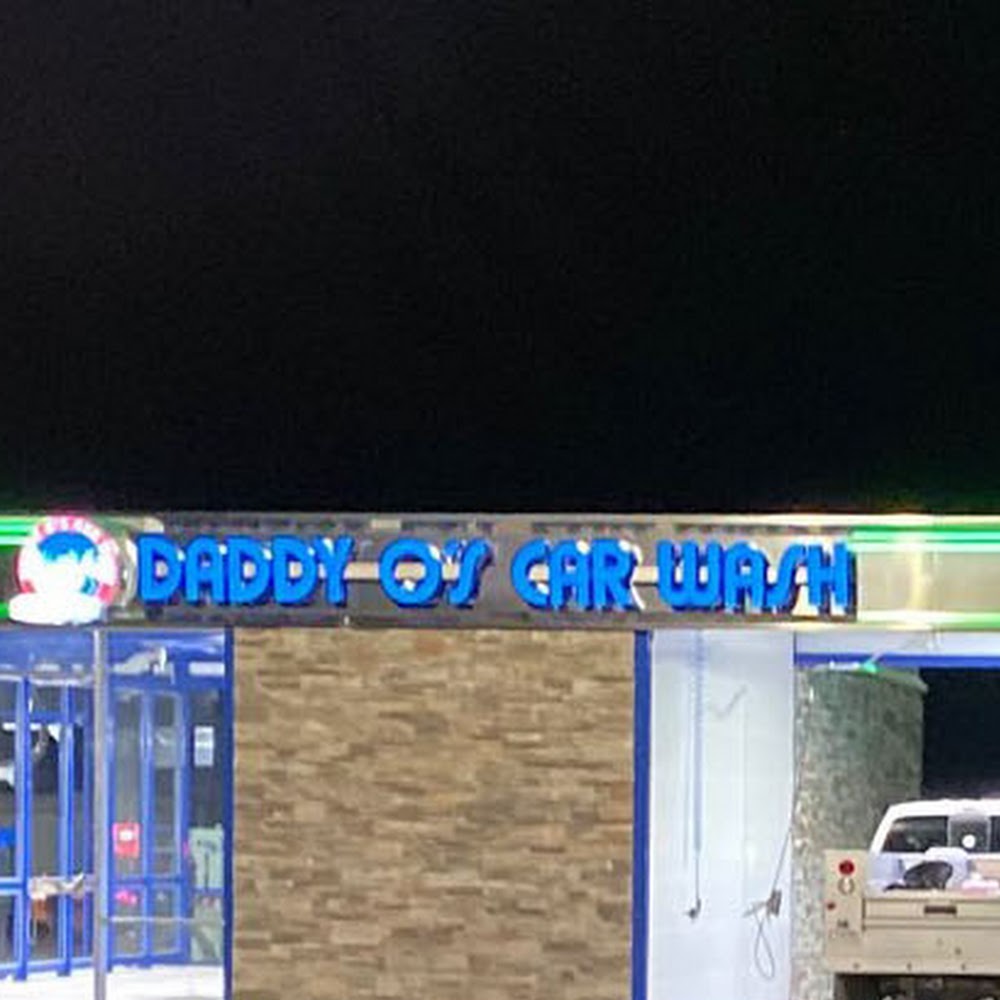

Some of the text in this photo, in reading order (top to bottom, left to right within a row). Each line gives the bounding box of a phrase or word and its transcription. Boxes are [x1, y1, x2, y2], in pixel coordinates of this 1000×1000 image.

[136, 533, 854, 611] DADDY O'S CAR WASH
